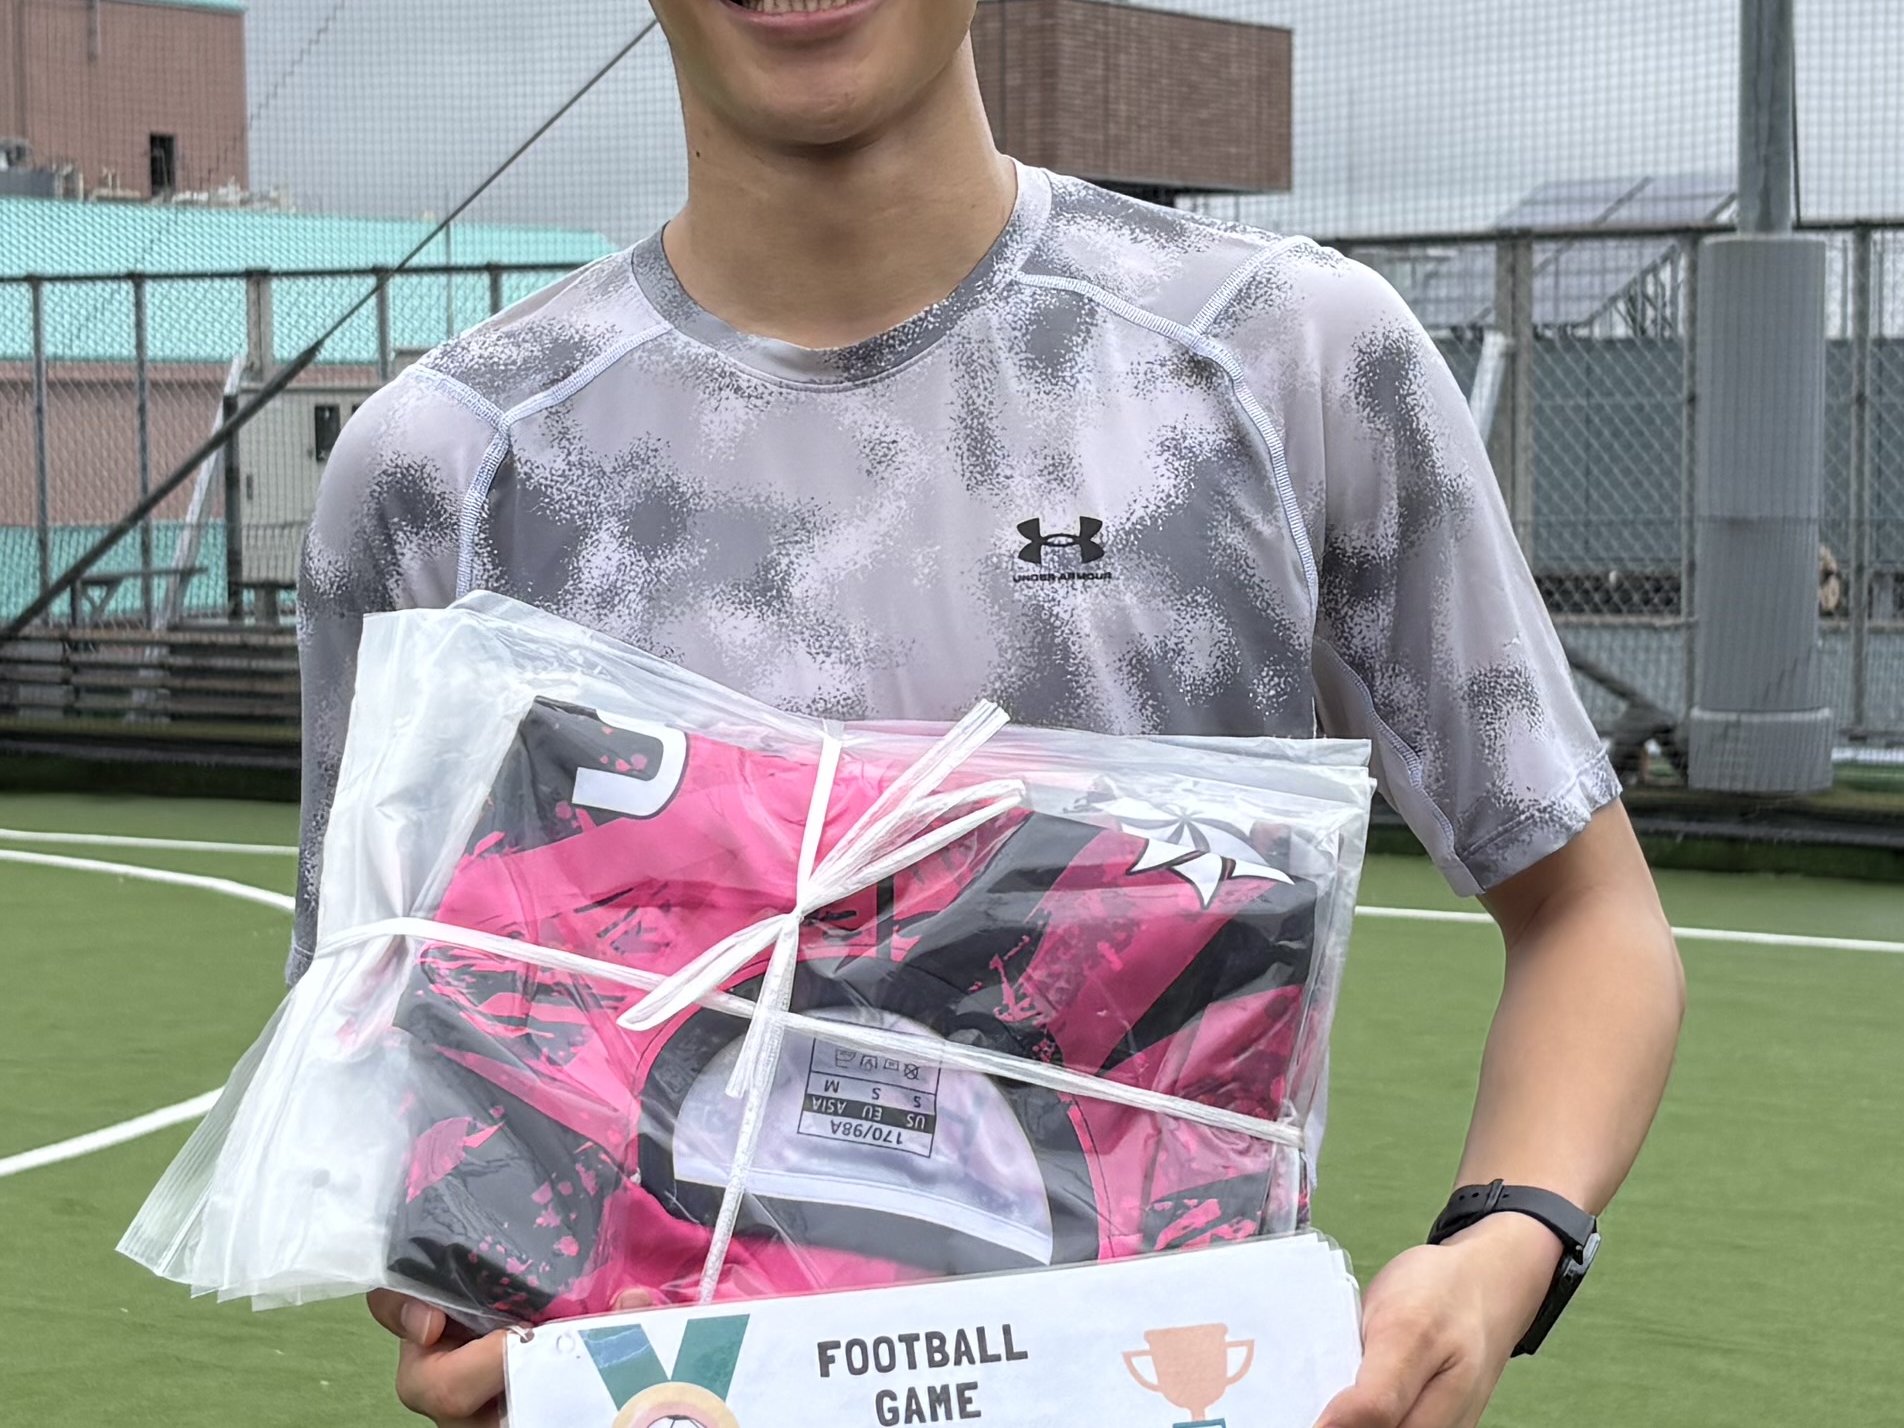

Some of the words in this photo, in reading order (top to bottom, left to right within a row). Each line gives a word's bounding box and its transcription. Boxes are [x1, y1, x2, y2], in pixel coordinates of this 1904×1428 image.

[1013, 573, 1056, 583] UNDER
[1058, 571, 1113, 582] ARMOUR
[824, 1080, 839, 1092] M
[872, 1088, 880, 1099] S
[812, 1097, 847, 1114] ASIA
[913, 1096, 921, 1107] S
[862, 1106, 883, 1121] EU
[906, 1113, 926, 1130] US
[830, 1119, 903, 1145] 170/98A
[817, 1324, 1028, 1377] FOOTBALL
[875, 1381, 982, 1427] GAME
